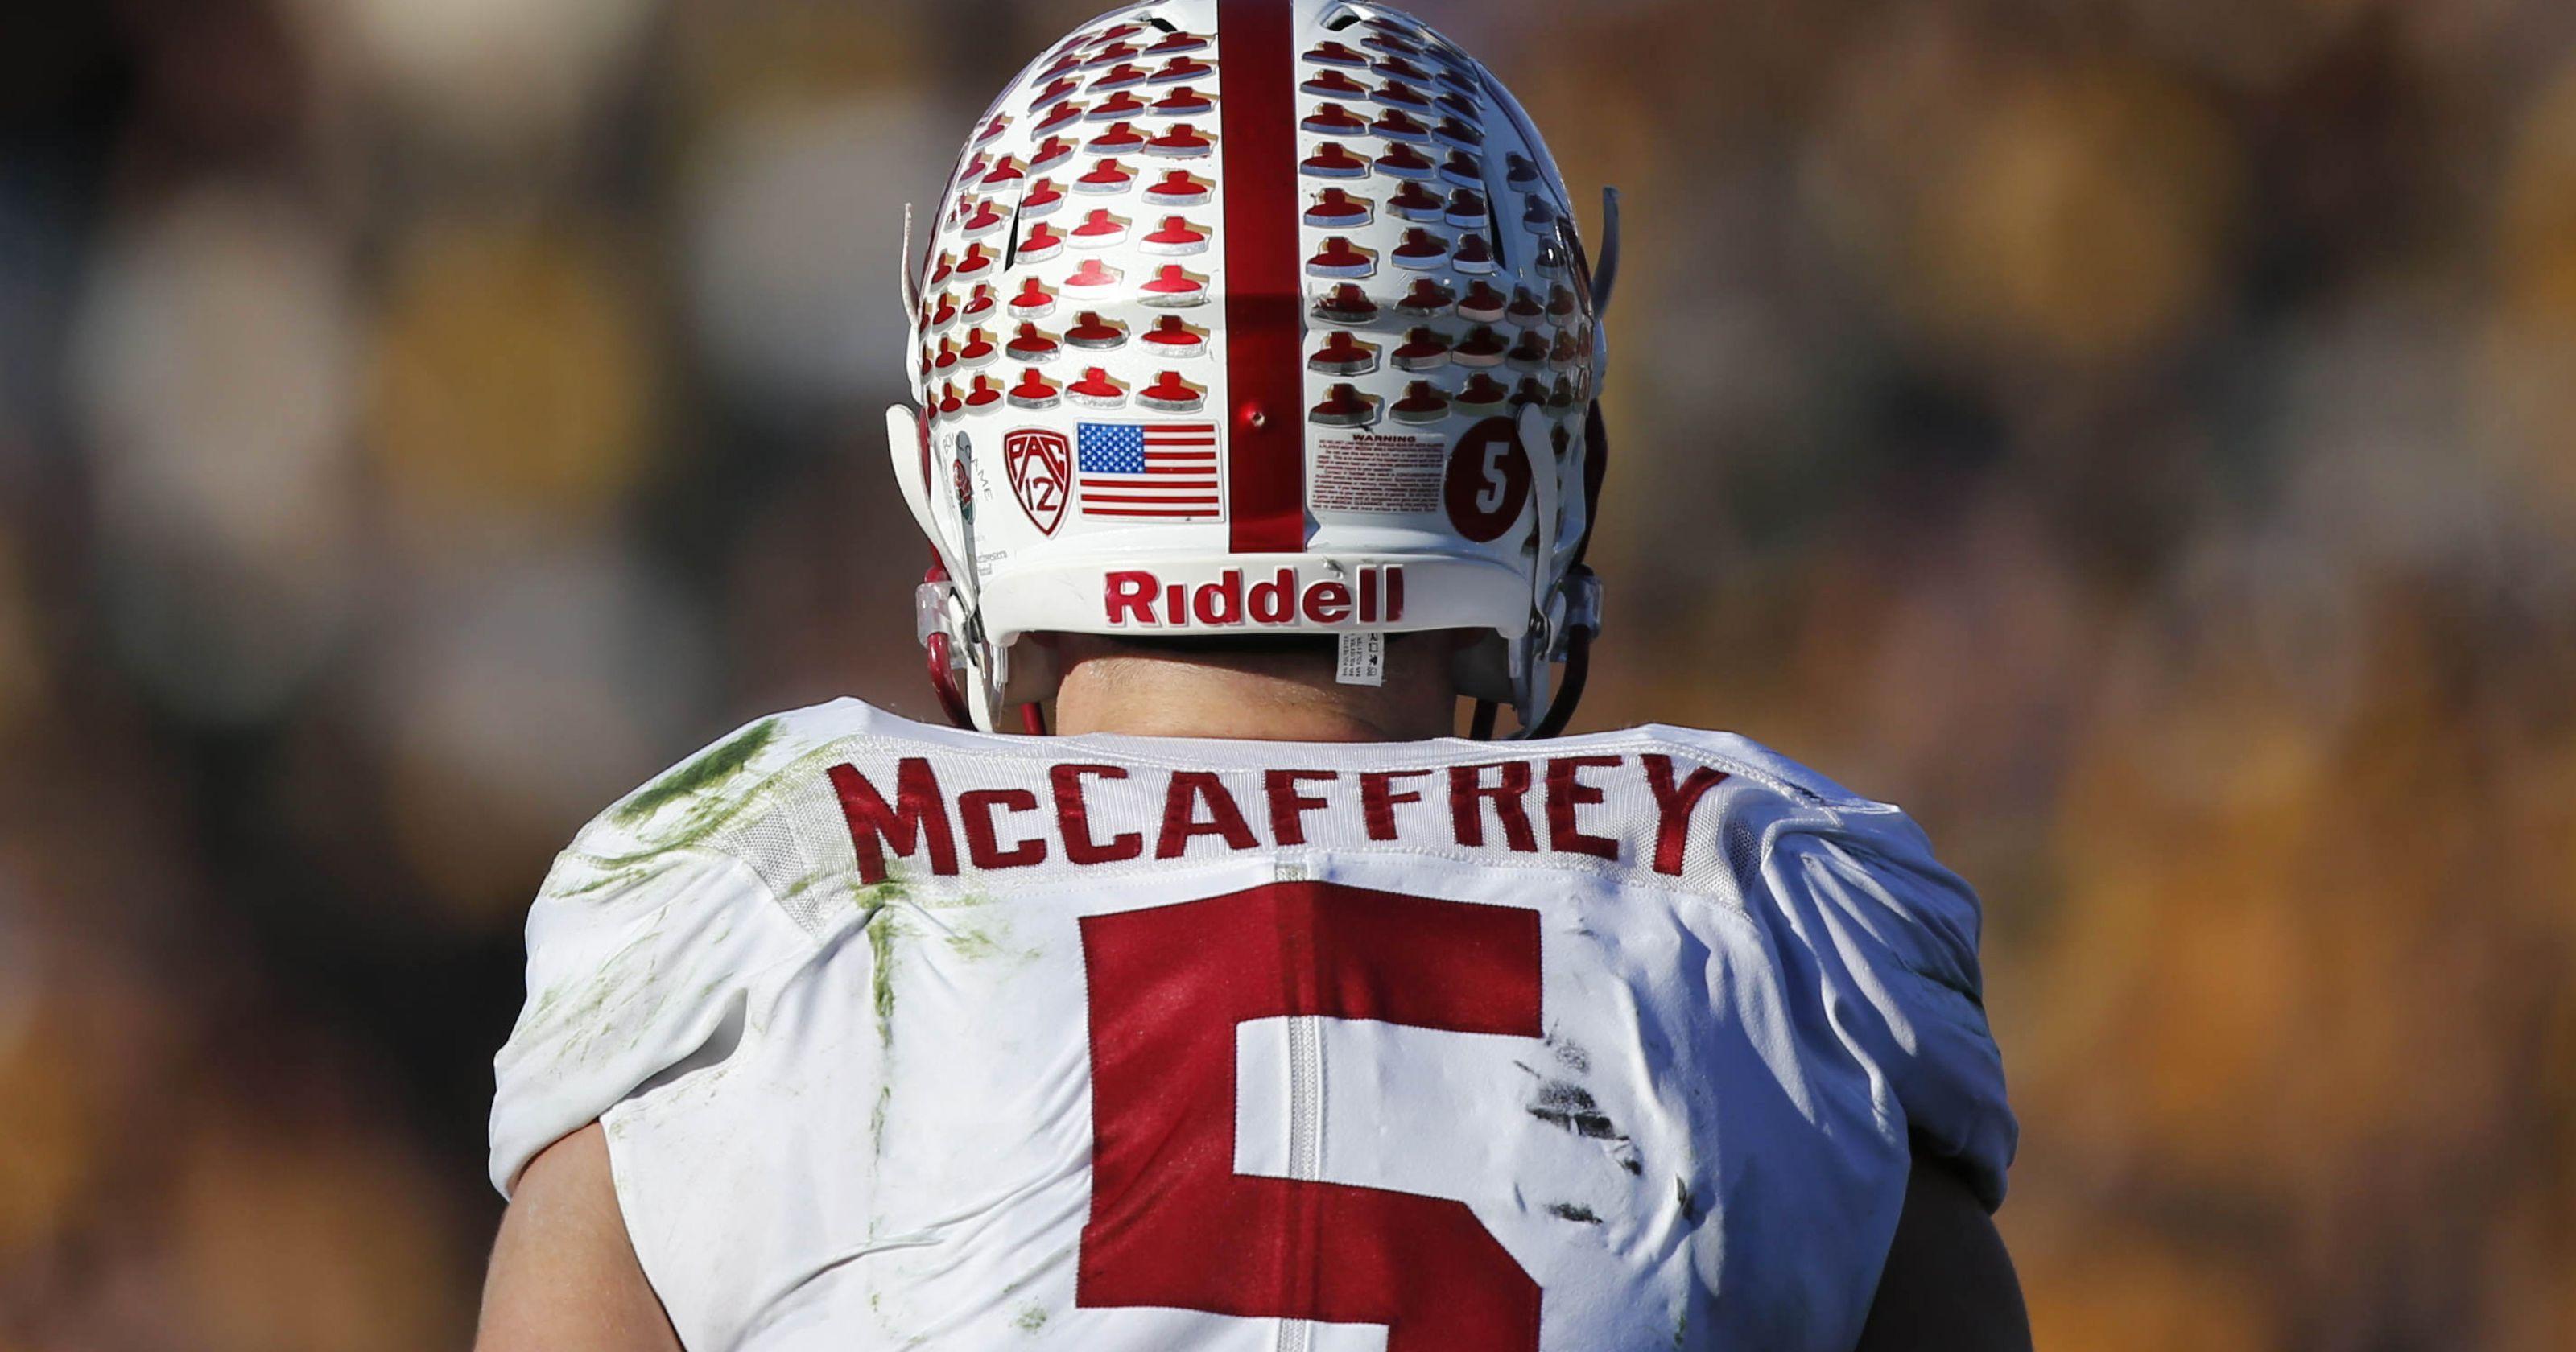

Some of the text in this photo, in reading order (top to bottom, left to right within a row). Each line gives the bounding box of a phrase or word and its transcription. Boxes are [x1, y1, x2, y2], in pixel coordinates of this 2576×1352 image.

[1007, 435, 1065, 493] PAC
[1352, 433, 1417, 443] WARNING
[1025, 476, 1058, 512] 12
[1476, 441, 1511, 514] 5
[1104, 564, 1405, 627] Riddell
[826, 753, 1729, 886] McCAFFREY
[1075, 880, 1544, 1352] 5
